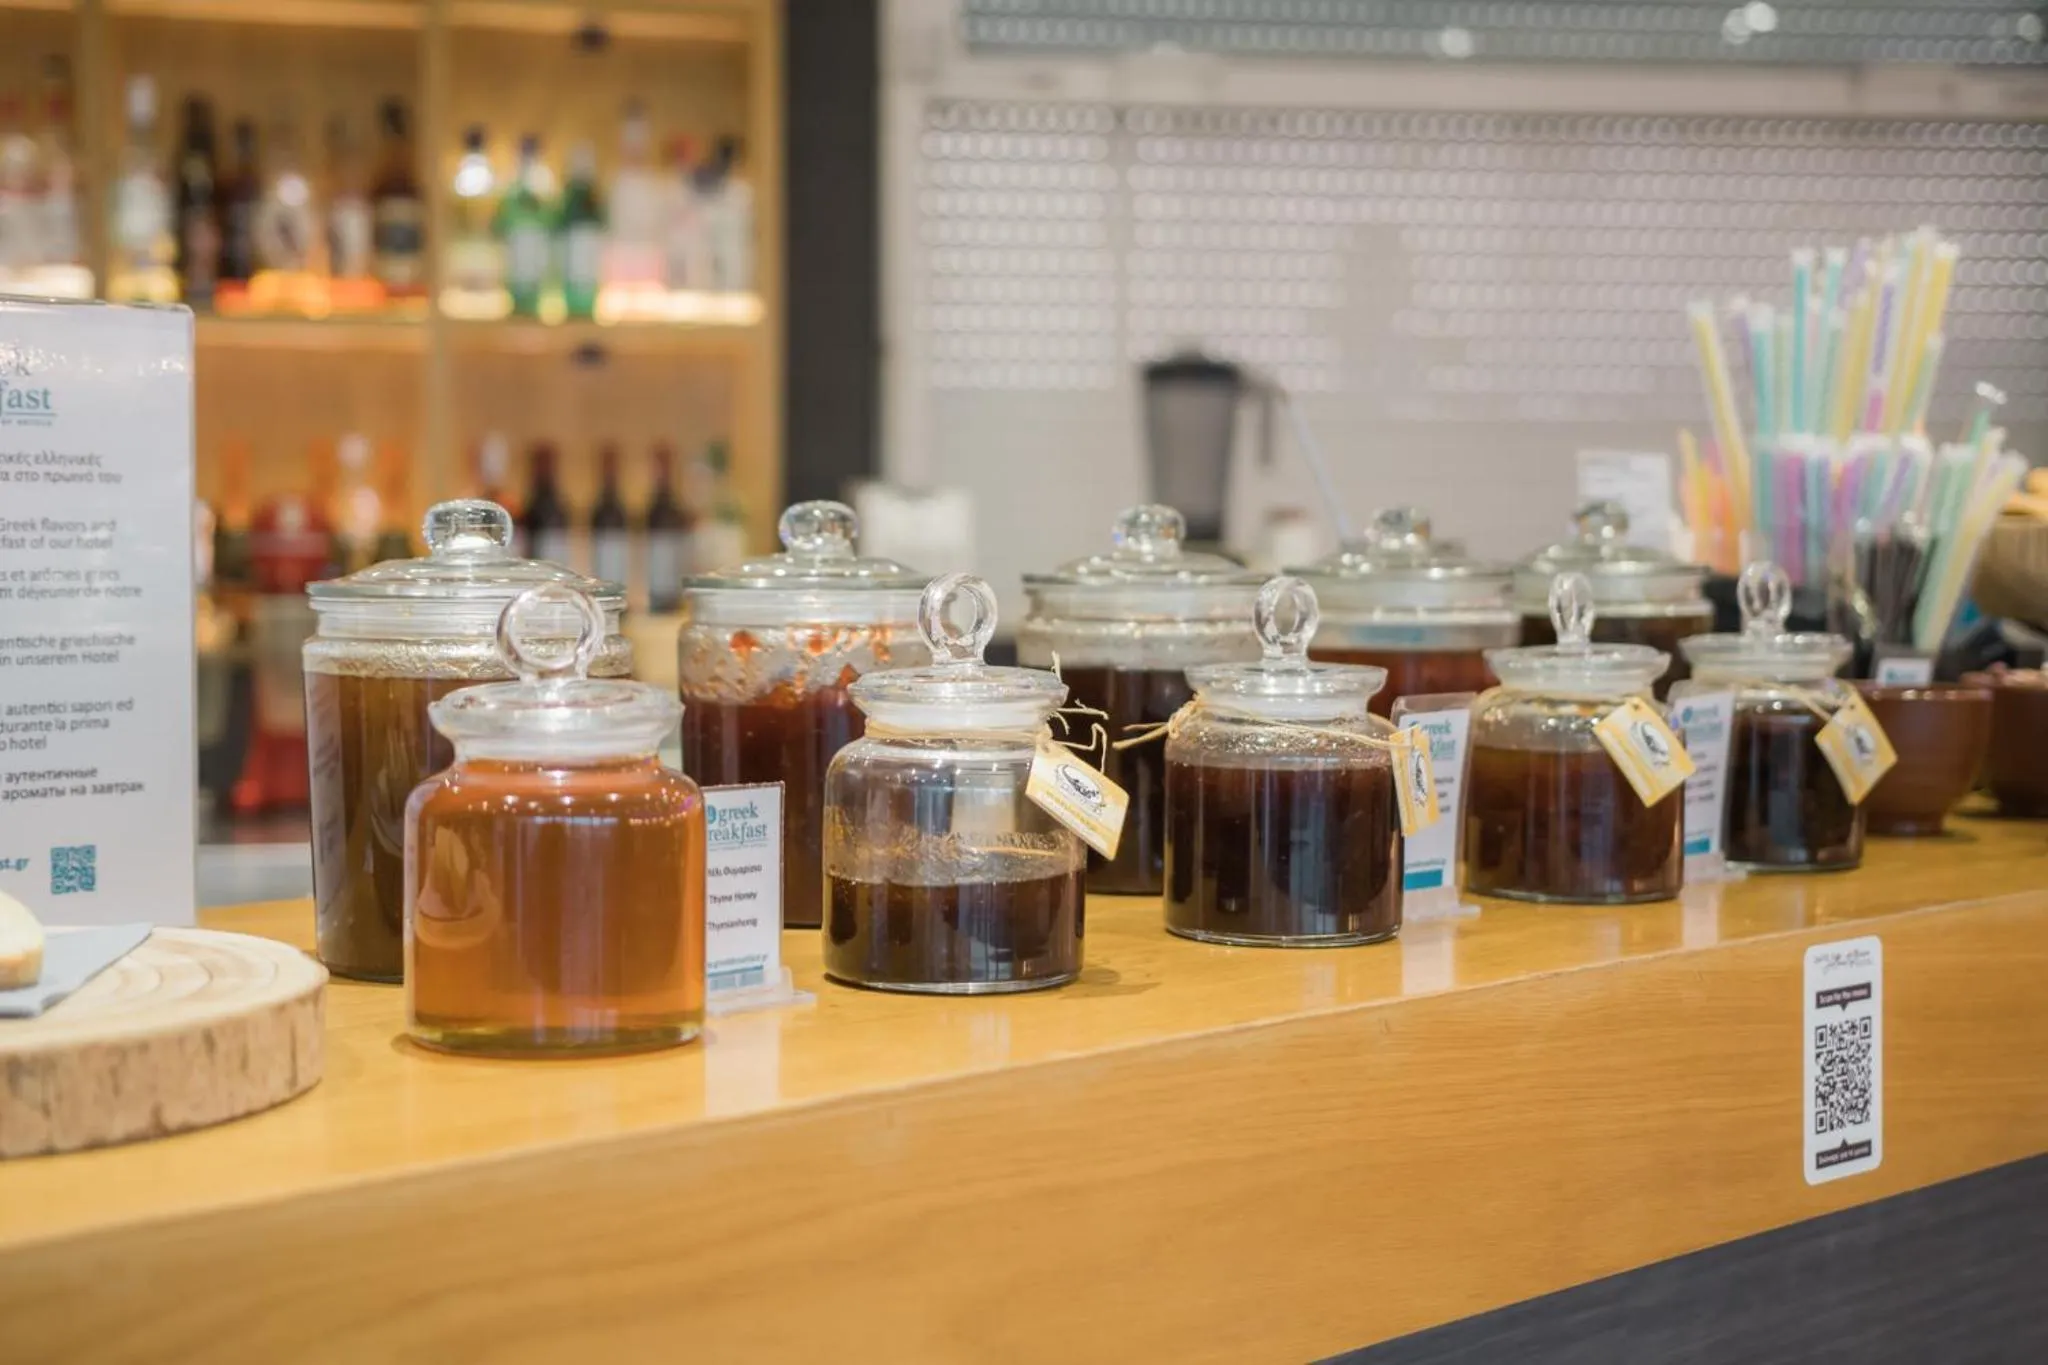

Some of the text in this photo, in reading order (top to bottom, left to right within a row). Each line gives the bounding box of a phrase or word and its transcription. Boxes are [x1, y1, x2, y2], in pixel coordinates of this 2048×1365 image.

[14, 470, 41, 482] στο
[30, 535, 44, 549] of
[48, 538, 73, 549] our
[16, 653, 78, 666] unserem
[81, 651, 120, 665] Hotel
[71, 698, 113, 716] sapori
[116, 697, 135, 711] ed
[70, 716, 110, 732] prima
[9, 735, 48, 750] hotel
[5, 766, 98, 784] аутентичные
[2, 780, 145, 803] ароматы на завтрак
[718, 800, 760, 826] greek
